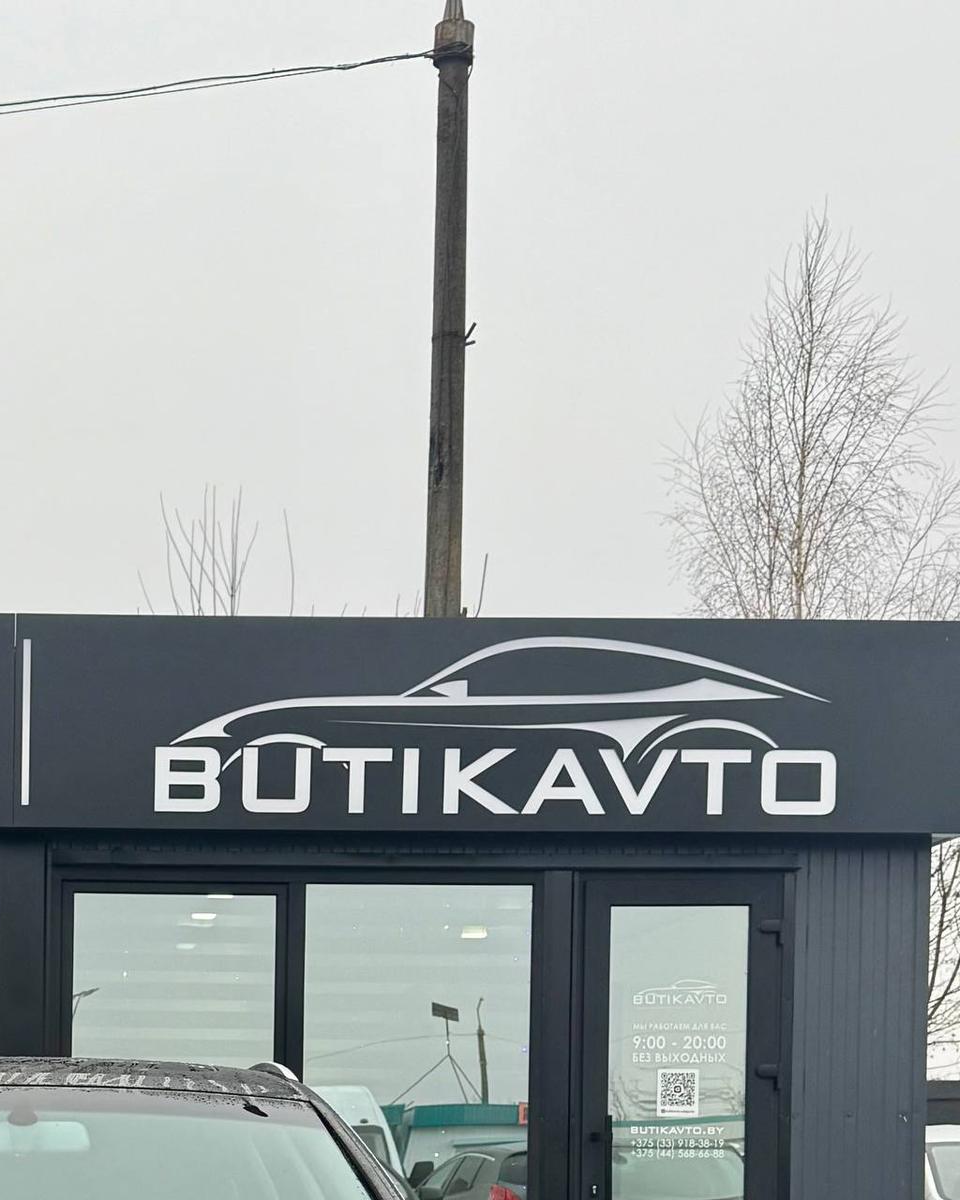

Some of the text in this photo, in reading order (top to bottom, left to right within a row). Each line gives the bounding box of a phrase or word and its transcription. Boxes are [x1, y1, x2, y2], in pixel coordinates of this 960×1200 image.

[153, 746, 837, 816] BUTIKAVTO
[632, 993, 727, 1005] BUTIKAVTO
[632, 1036, 666, 1049] 9:00
[683, 1036, 726, 1049] 20:00
[632, 1053, 726, 1063] БЕЗ ВЫХОДНЫХ
[630, 1126, 724, 1135] BUTIKAVTO.BY
[630, 1138, 724, 1149] +375 (33) 918-38-19
[630, 1149, 725, 1160] +375 (44) 568-66-88
